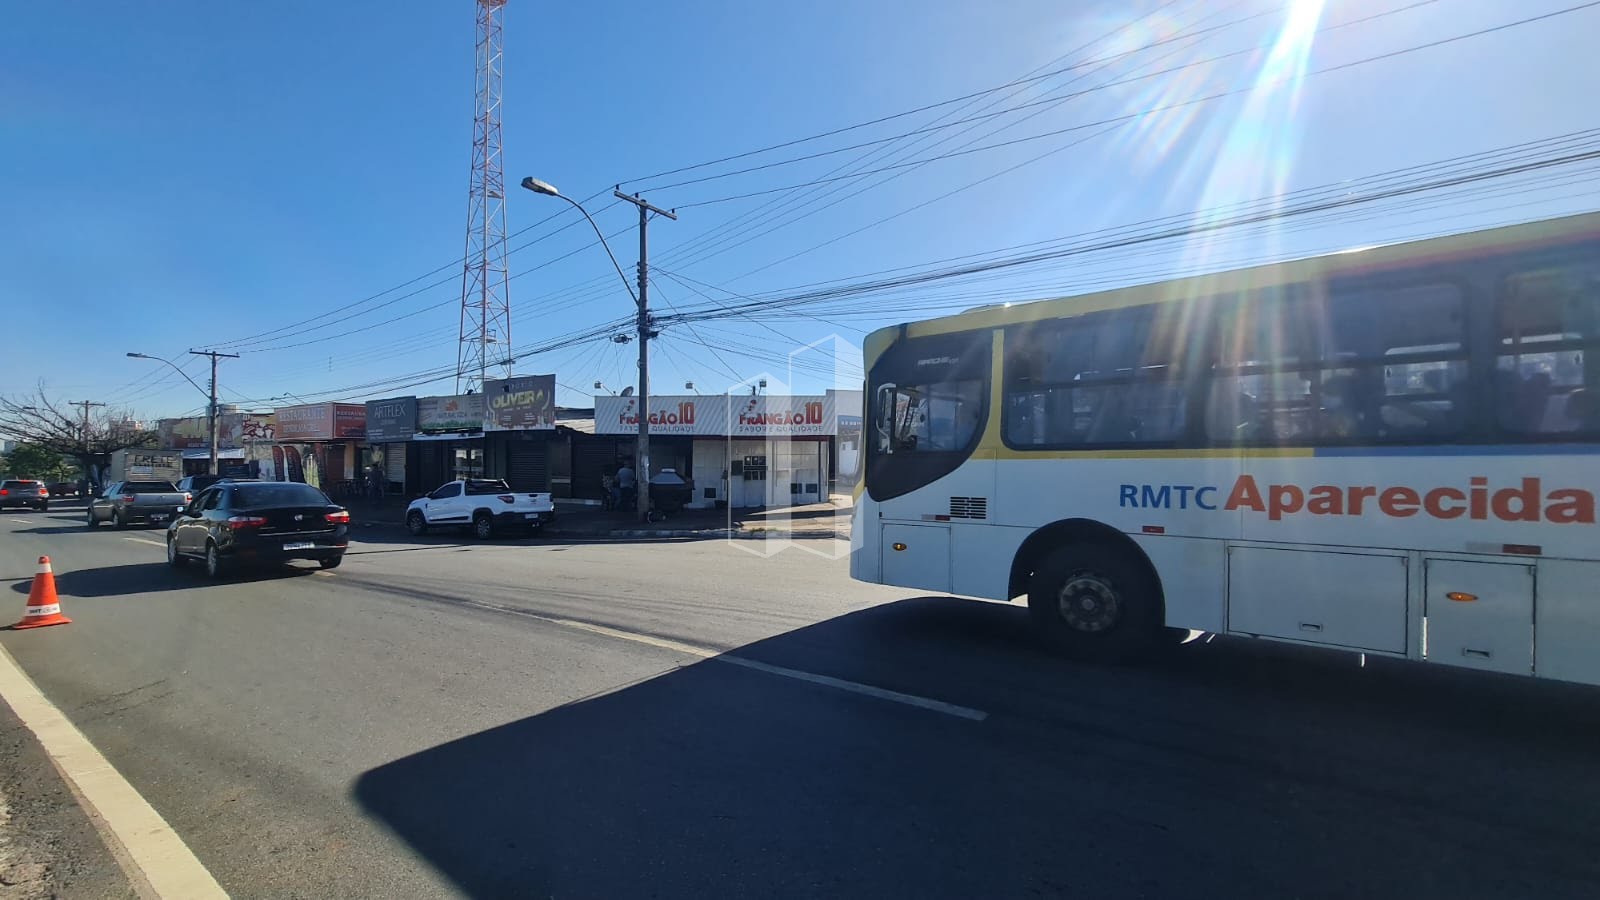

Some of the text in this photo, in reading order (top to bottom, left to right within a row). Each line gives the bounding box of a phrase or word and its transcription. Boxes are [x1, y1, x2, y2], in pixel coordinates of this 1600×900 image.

[492, 389, 544, 409] OLIVEIRA
[374, 403, 407, 419] ARTFLEX
[619, 402, 695, 425] FRAGÃO 10
[739, 402, 823, 425] FRANGÃO 10
[776, 425, 824, 433] QUALIDADE
[1119, 474, 1595, 525] RMTC Aparecida
